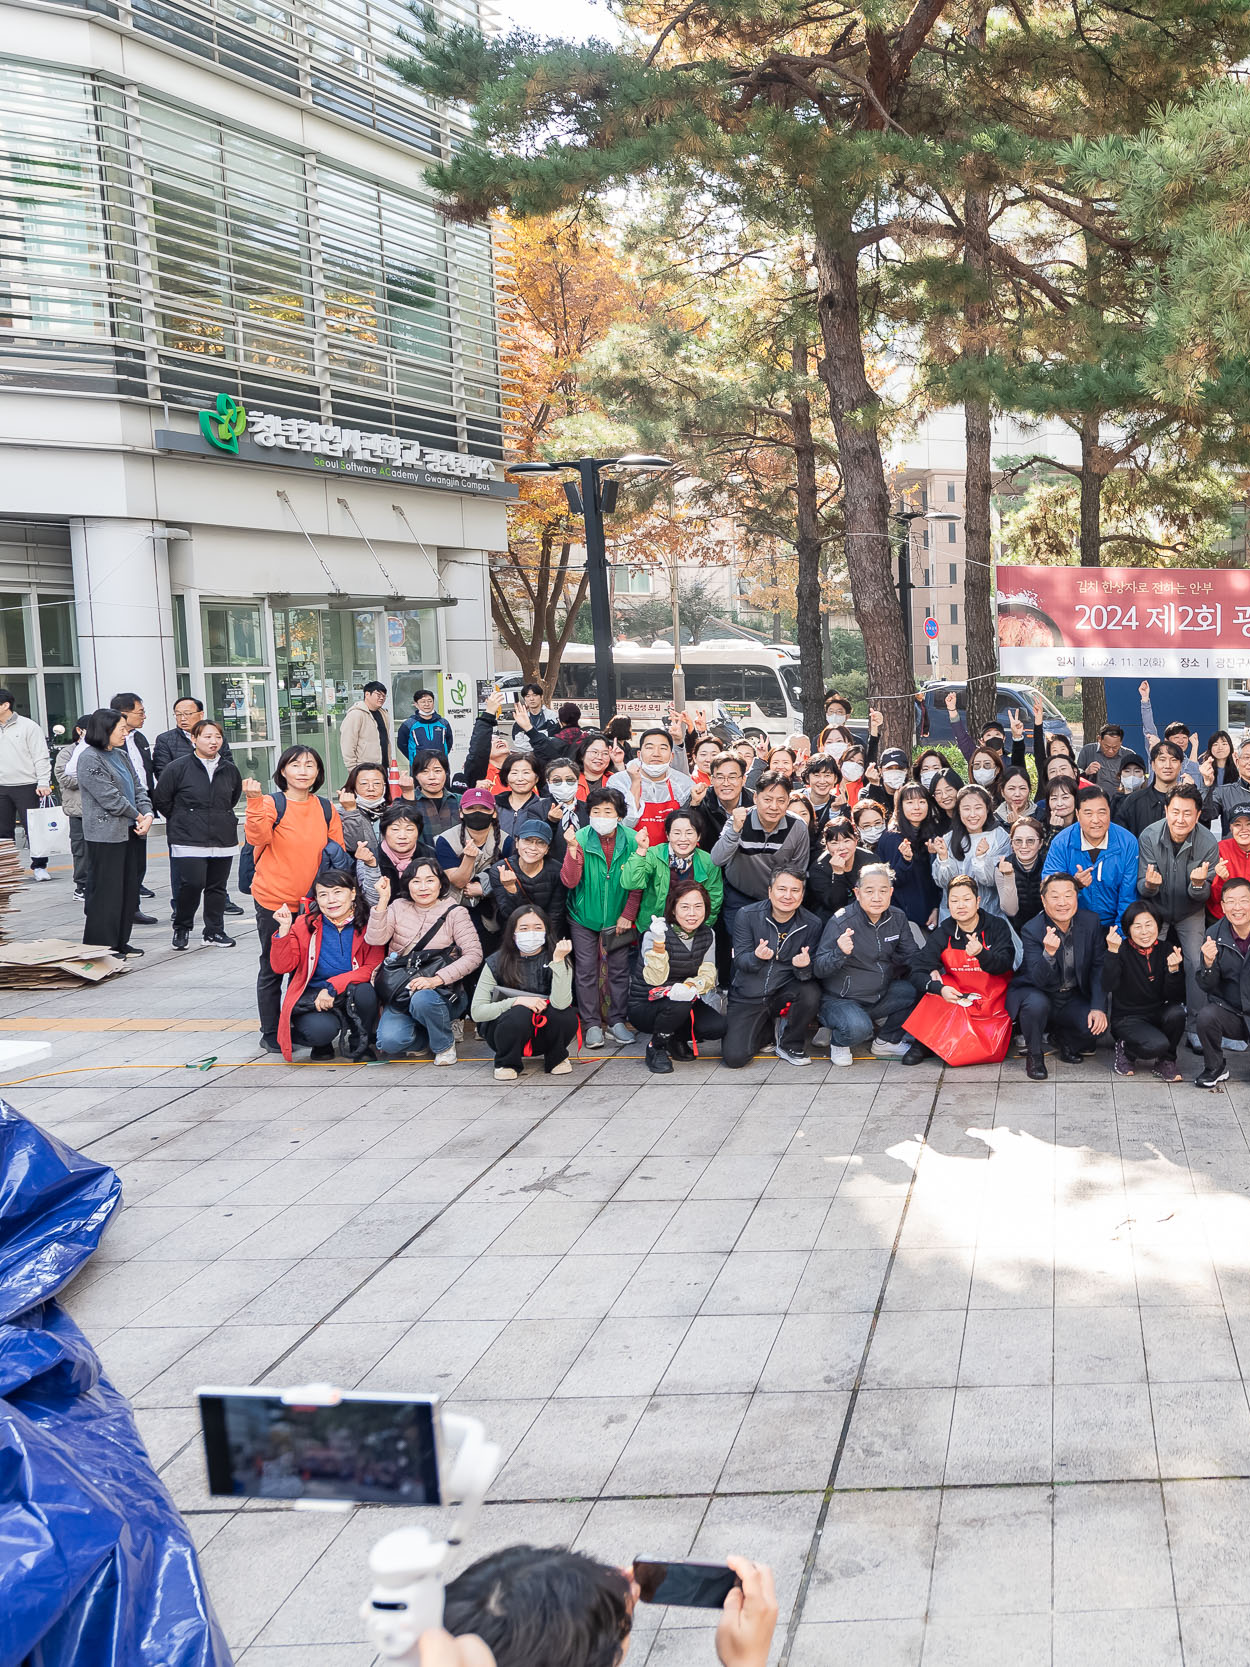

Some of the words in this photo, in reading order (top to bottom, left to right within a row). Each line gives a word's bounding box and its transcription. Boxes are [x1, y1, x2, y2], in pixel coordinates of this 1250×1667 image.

[313, 457, 339, 469] Seoul
[340, 460, 377, 474] Software
[379, 467, 419, 482] ACademy
[424, 473, 460, 487] Gwangjin
[461, 479, 490, 491] Campus
[1076, 580, 1099, 594] 김치
[1101, 581, 1150, 594] 한상자로
[1152, 581, 1187, 595] 전하는
[1189, 582, 1214, 595] 안부
[1075, 604, 1139, 630] 2024
[1146, 602, 1221, 636] 제2회
[1056, 656, 1076, 667] 일시
[1180, 657, 1200, 668] 장소
[628, 703, 647, 711] 수강생
[648, 704, 661, 712] 모집
